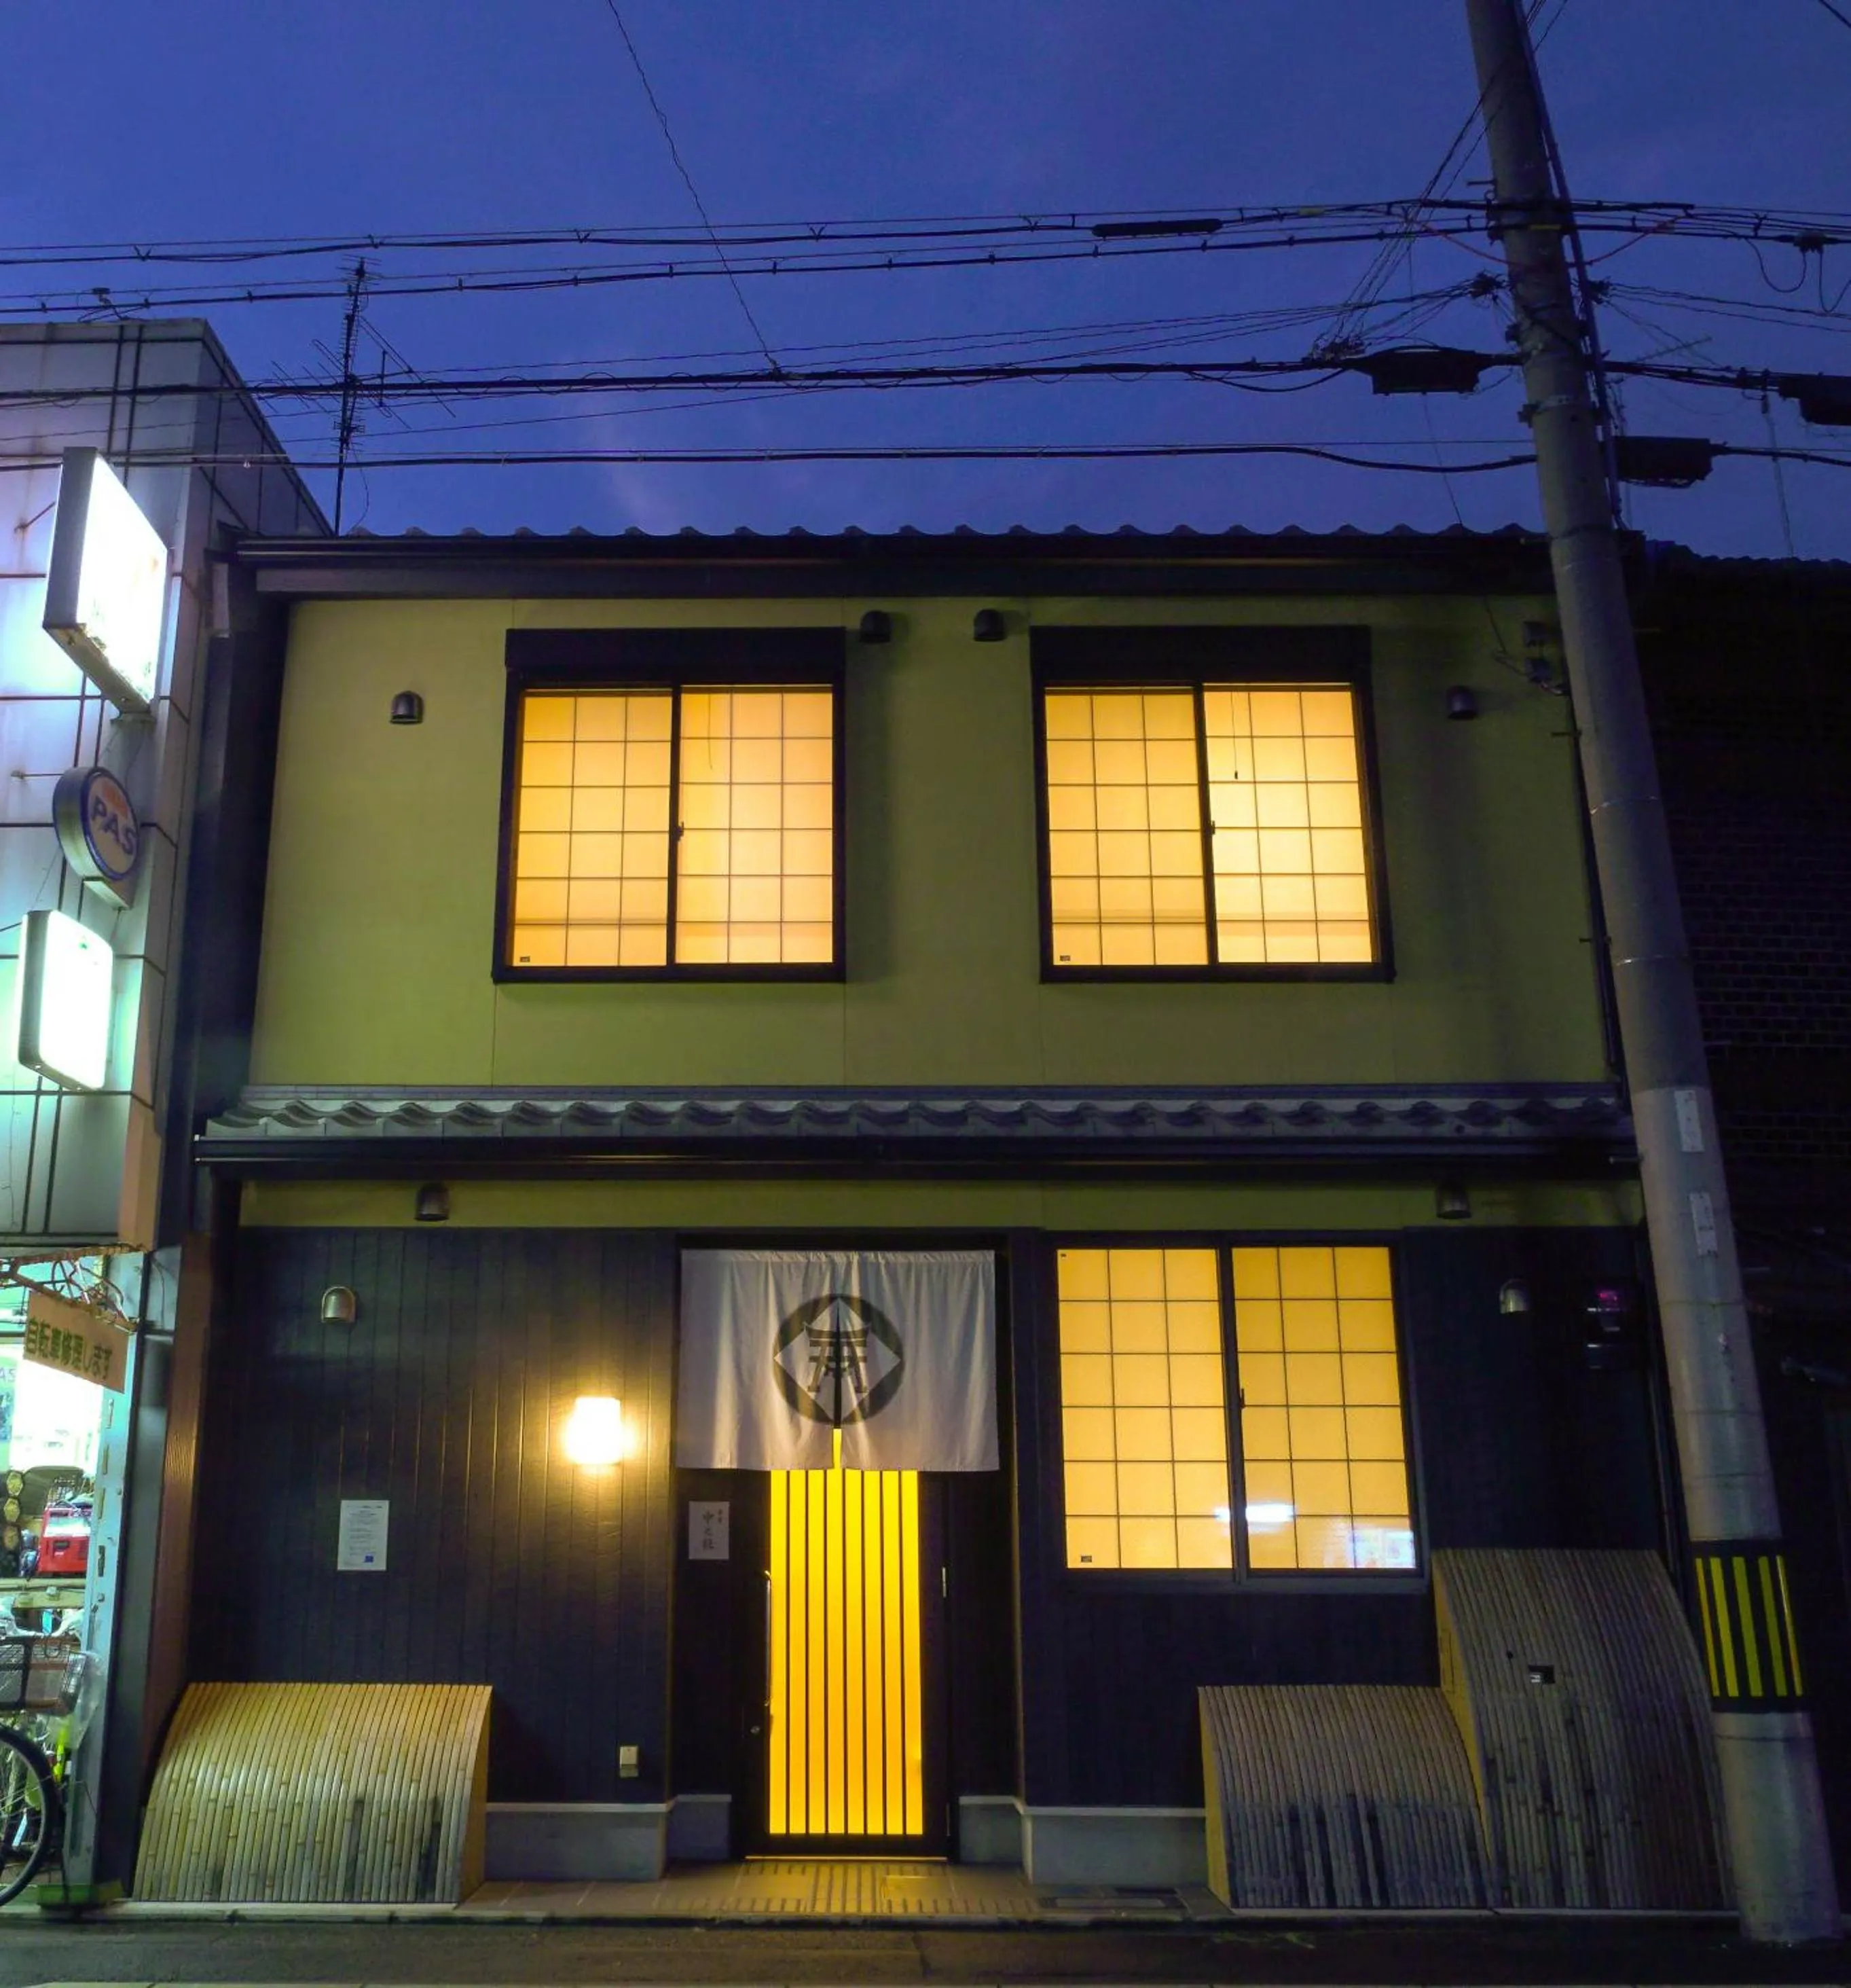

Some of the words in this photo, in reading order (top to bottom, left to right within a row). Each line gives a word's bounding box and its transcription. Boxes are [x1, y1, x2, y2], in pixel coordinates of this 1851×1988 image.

[92, 795, 136, 855] PAS
[26, 1317, 113, 1380] 自転車修理します
